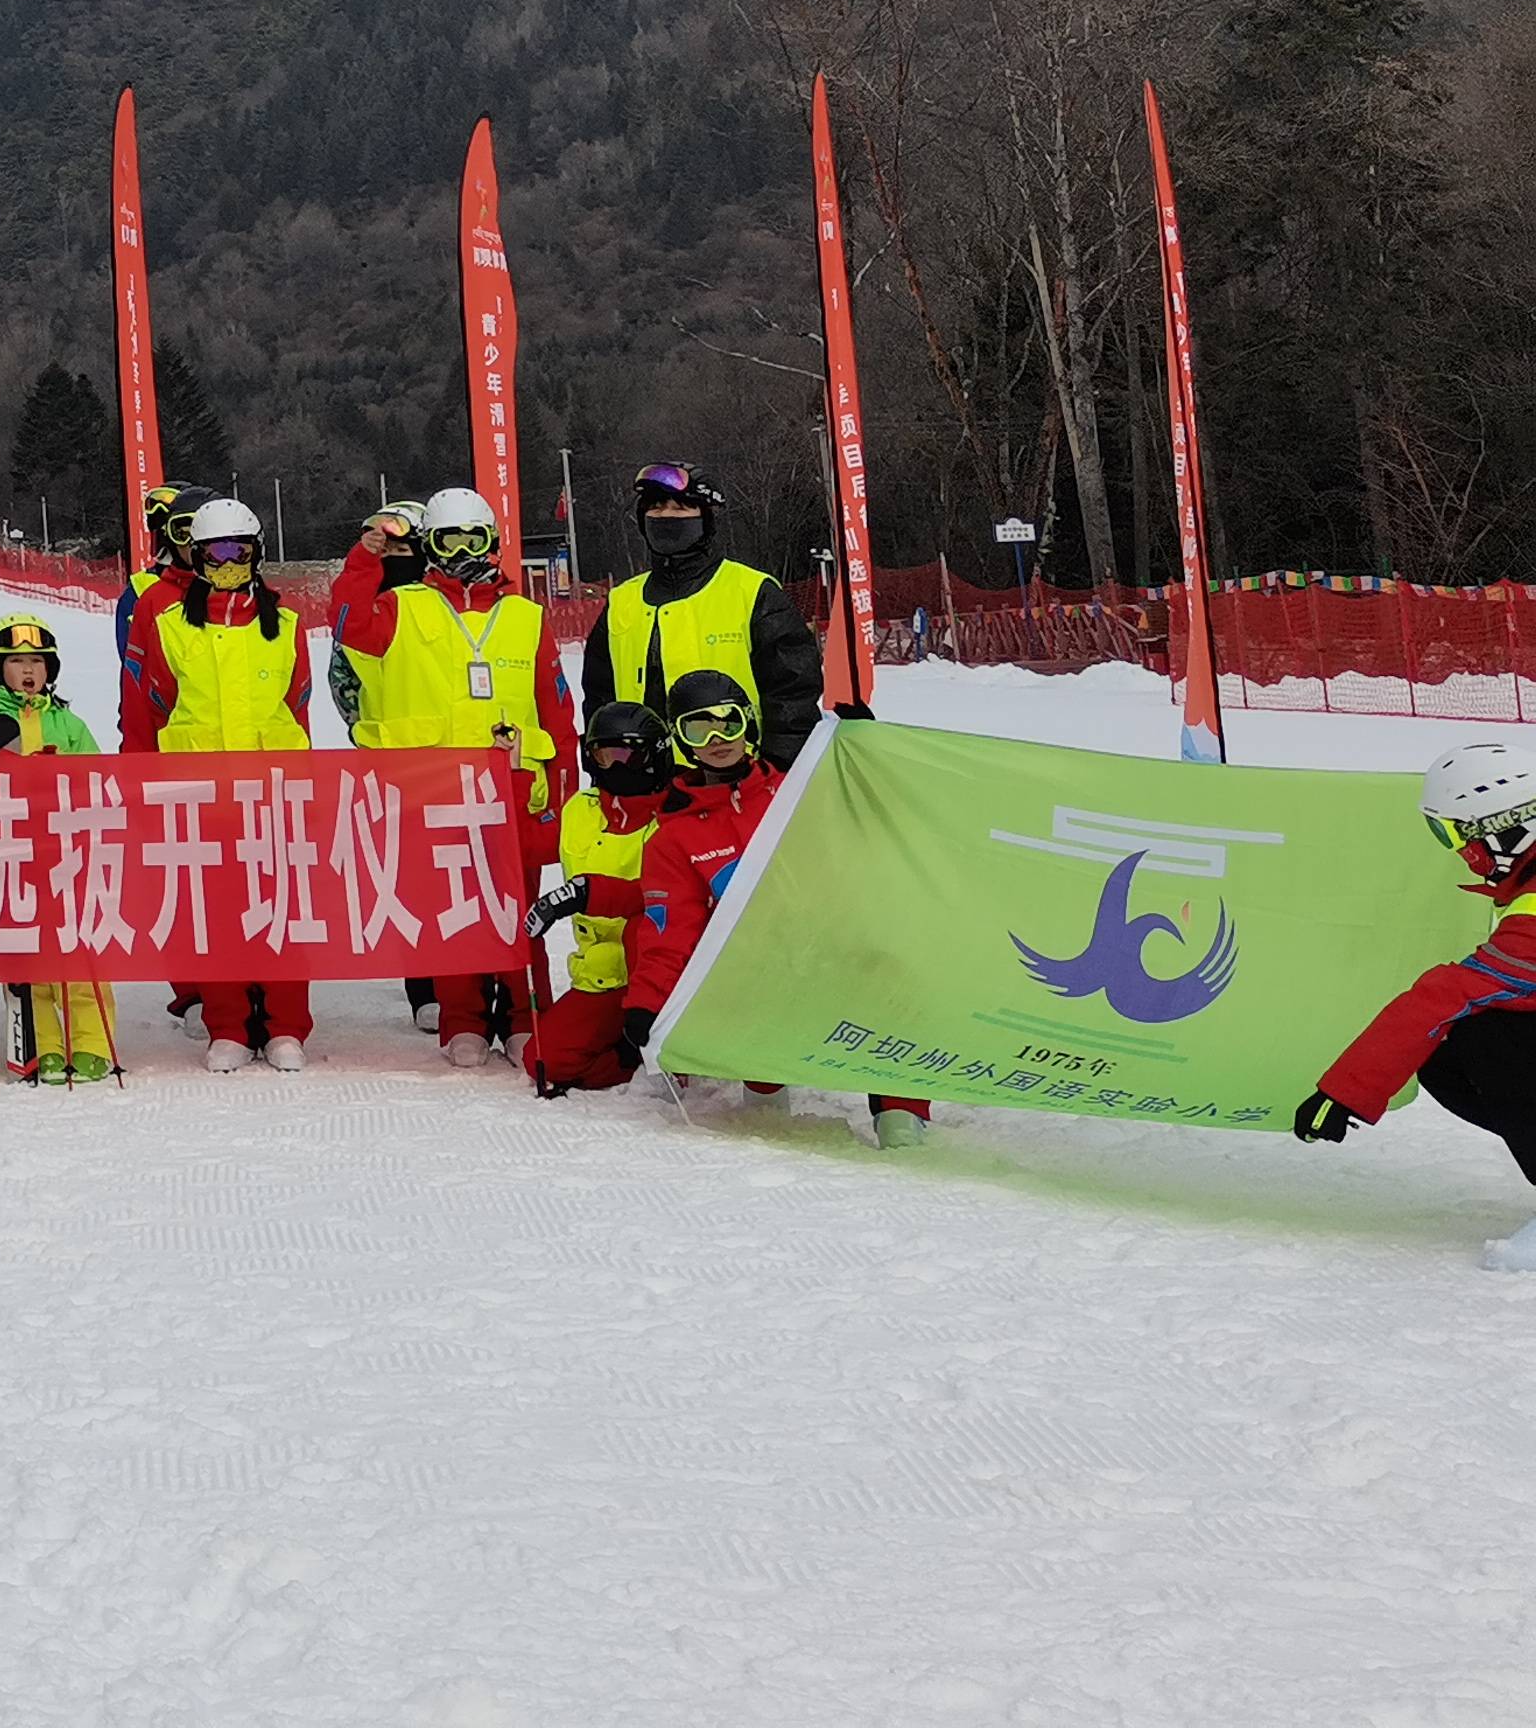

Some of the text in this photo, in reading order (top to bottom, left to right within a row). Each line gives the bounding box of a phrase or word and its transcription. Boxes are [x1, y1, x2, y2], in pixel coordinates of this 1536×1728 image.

[824, 1019, 1274, 1123] 阿坝州外国语实验小学
[1013, 1045, 1117, 1077] 1975年
